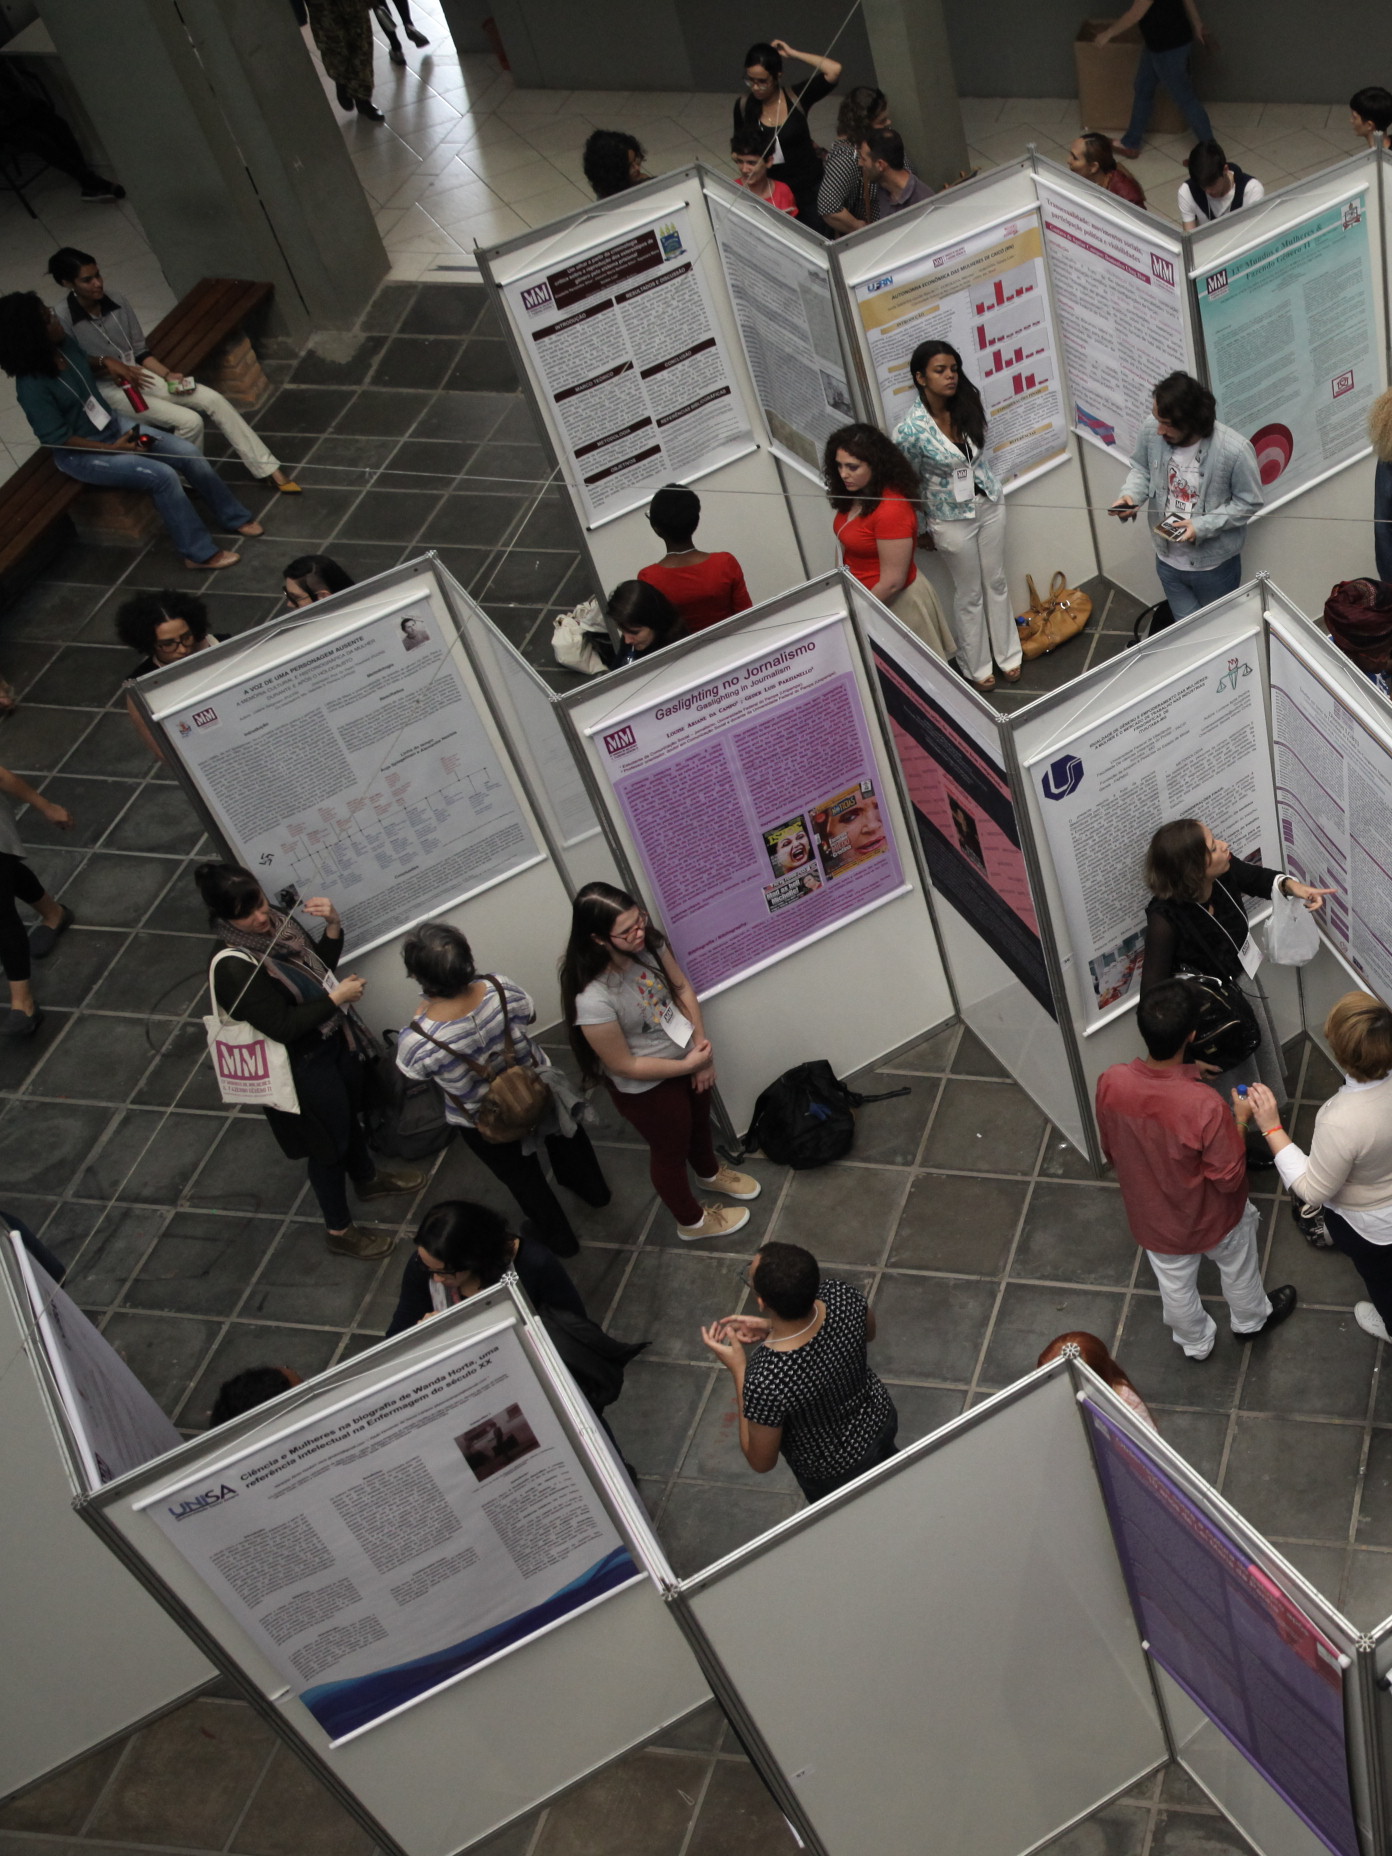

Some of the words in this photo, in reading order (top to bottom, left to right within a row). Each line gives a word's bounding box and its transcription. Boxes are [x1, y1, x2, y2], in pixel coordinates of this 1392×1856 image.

[653, 682, 720, 723] Gaslighting
[721, 674, 740, 690] no
[741, 638, 816, 681] Jornalismo
[695, 687, 739, 713] Gaslighting
[740, 682, 749, 692] in
[749, 663, 791, 688] Journalism
[238, 1456, 279, 1482] Ciência
[287, 1427, 336, 1456] Mulheres
[337, 1421, 351, 1432] na
[351, 1397, 398, 1425] biografia
[397, 1391, 411, 1402] de
[411, 1373, 447, 1395] Wanda
[446, 1357, 478, 1378] Horta,
[477, 1344, 500, 1361] uma
[242, 1456, 298, 1489] referência
[296, 1429, 351, 1461] intelectual
[351, 1423, 365, 1434] na
[365, 1391, 430, 1428] Enfermagem
[429, 1383, 444, 1395] do
[443, 1366, 478, 1388] século
[477, 1357, 493, 1370] XX
[167, 1478, 237, 1523] UNISA
